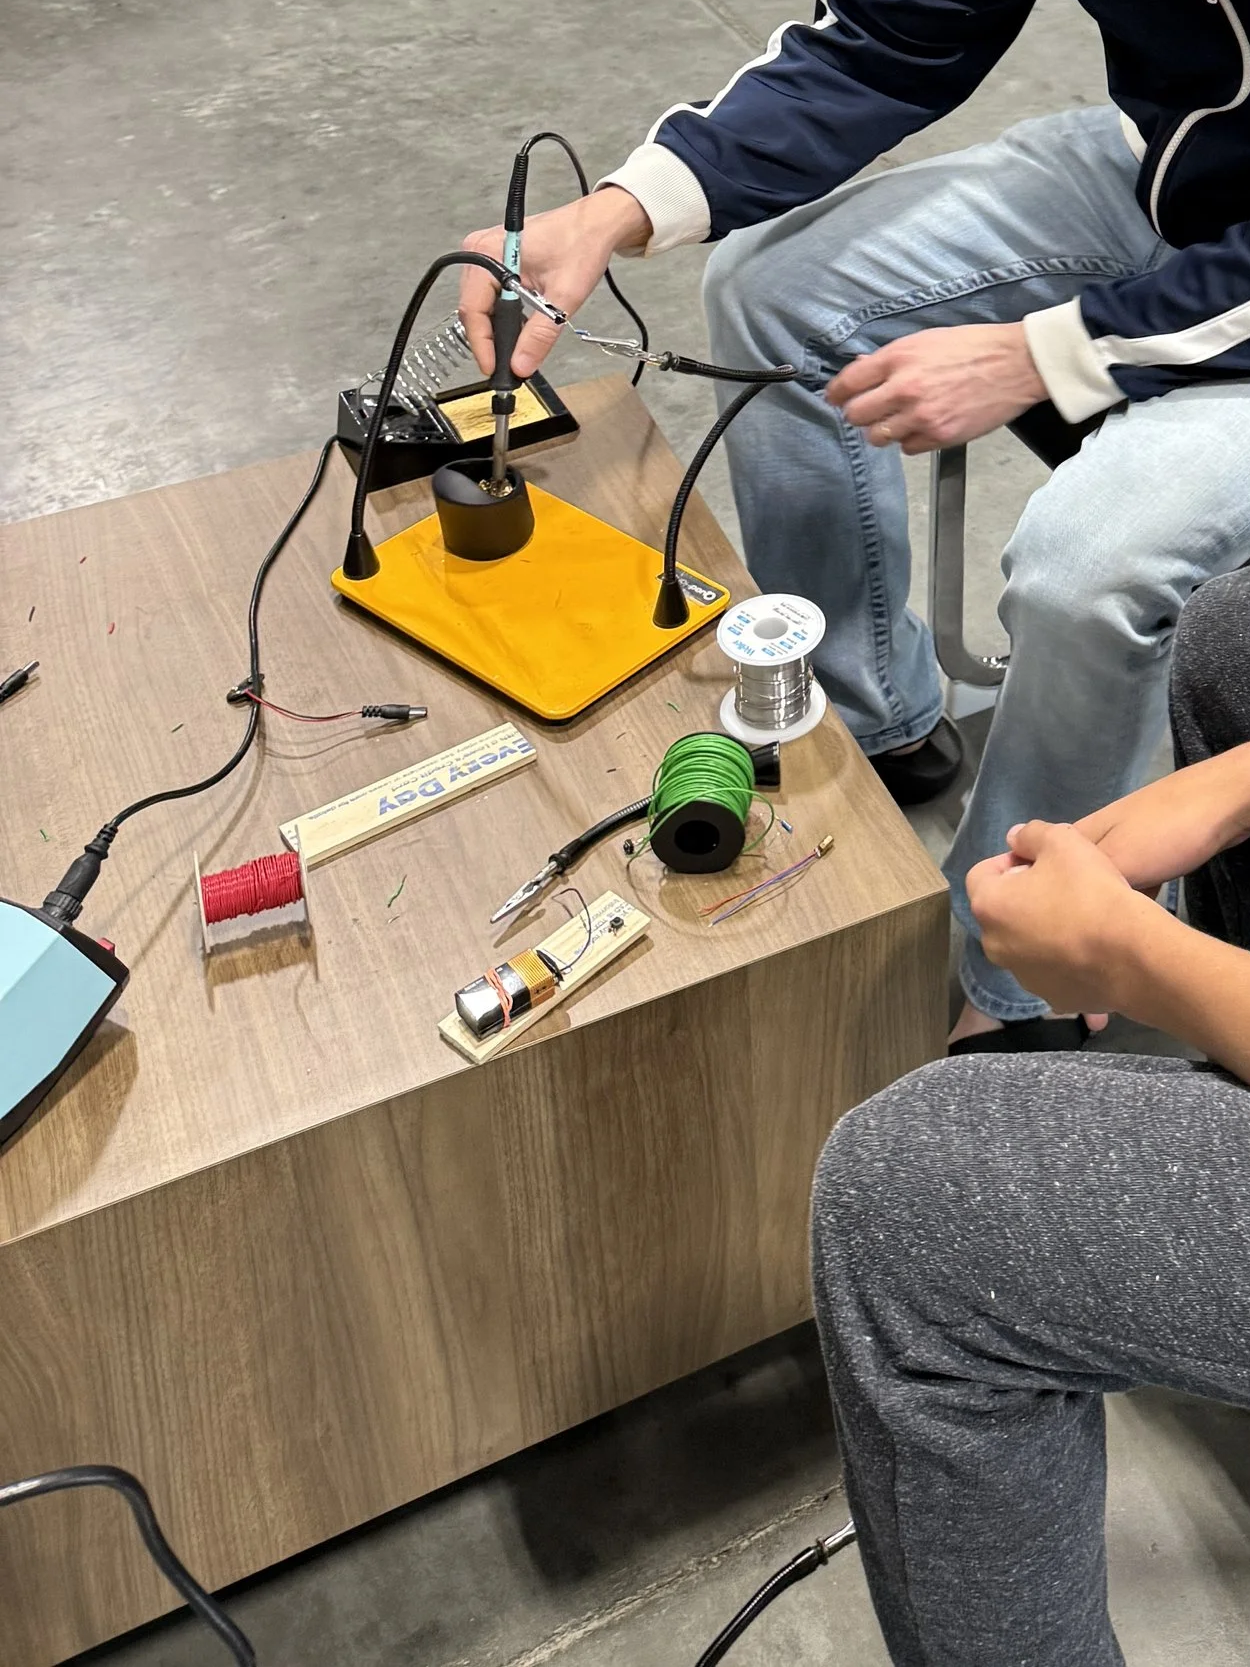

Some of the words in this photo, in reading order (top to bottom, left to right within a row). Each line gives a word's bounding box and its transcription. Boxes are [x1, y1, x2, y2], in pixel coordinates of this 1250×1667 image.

[420, 760, 454, 779] Credit
[449, 737, 535, 783] Every
[379, 777, 446, 815] Day
[391, 776, 419, 793] Card
